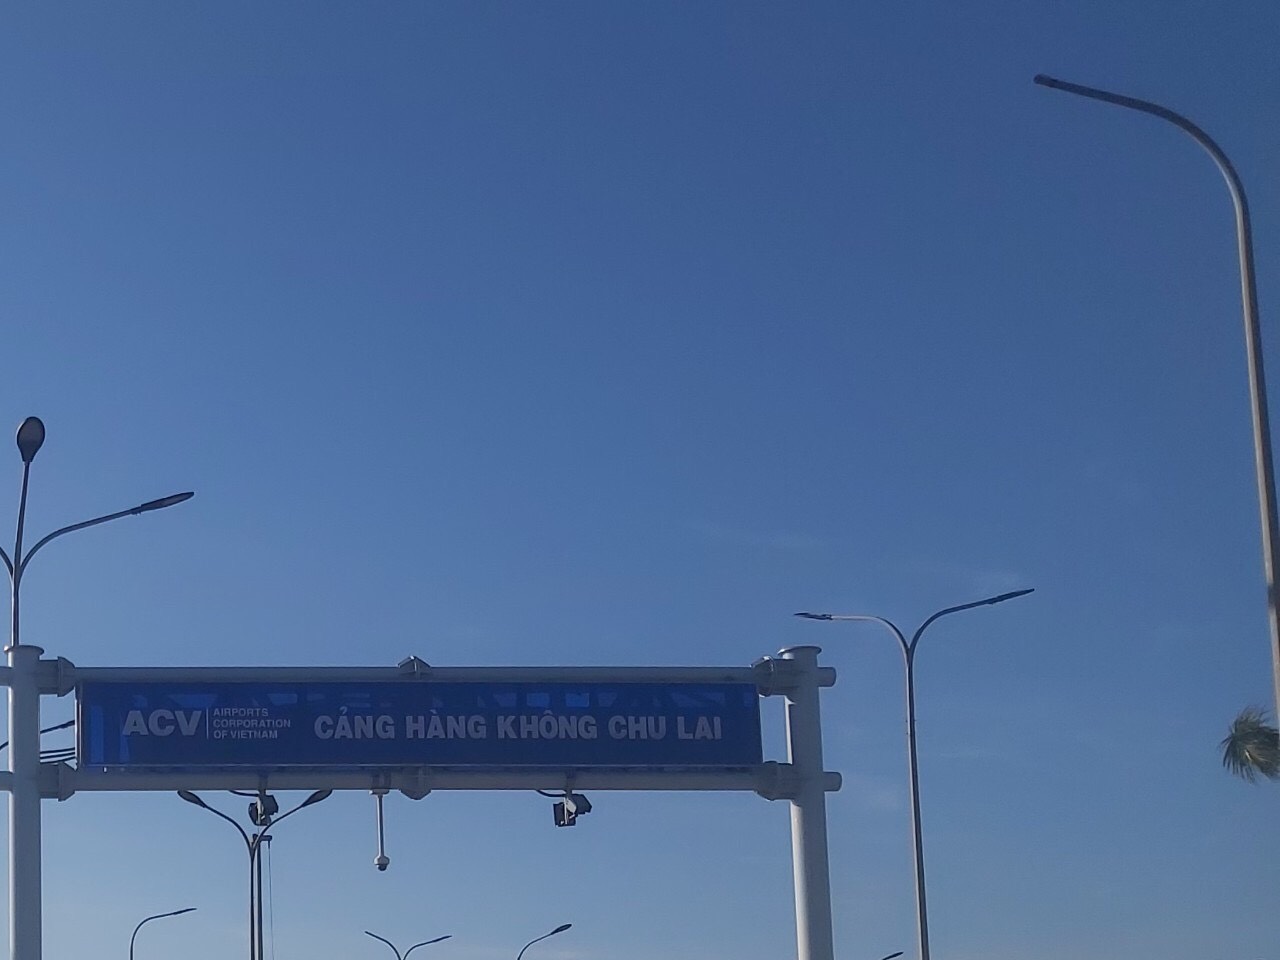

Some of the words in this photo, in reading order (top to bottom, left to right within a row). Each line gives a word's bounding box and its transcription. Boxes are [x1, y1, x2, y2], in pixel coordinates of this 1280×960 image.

[213, 708, 269, 717] AIRPORTS
[122, 709, 202, 737] ACV
[213, 719, 291, 728] CORPORATION
[313, 706, 396, 740] CẢNG
[405, 709, 487, 740] HÀNG
[497, 709, 598, 740] KHÔNG
[608, 714, 667, 740] CHU
[677, 715, 723, 740] LAI
[213, 730, 227, 739] OF
[230, 730, 277, 739] VIETNAM
